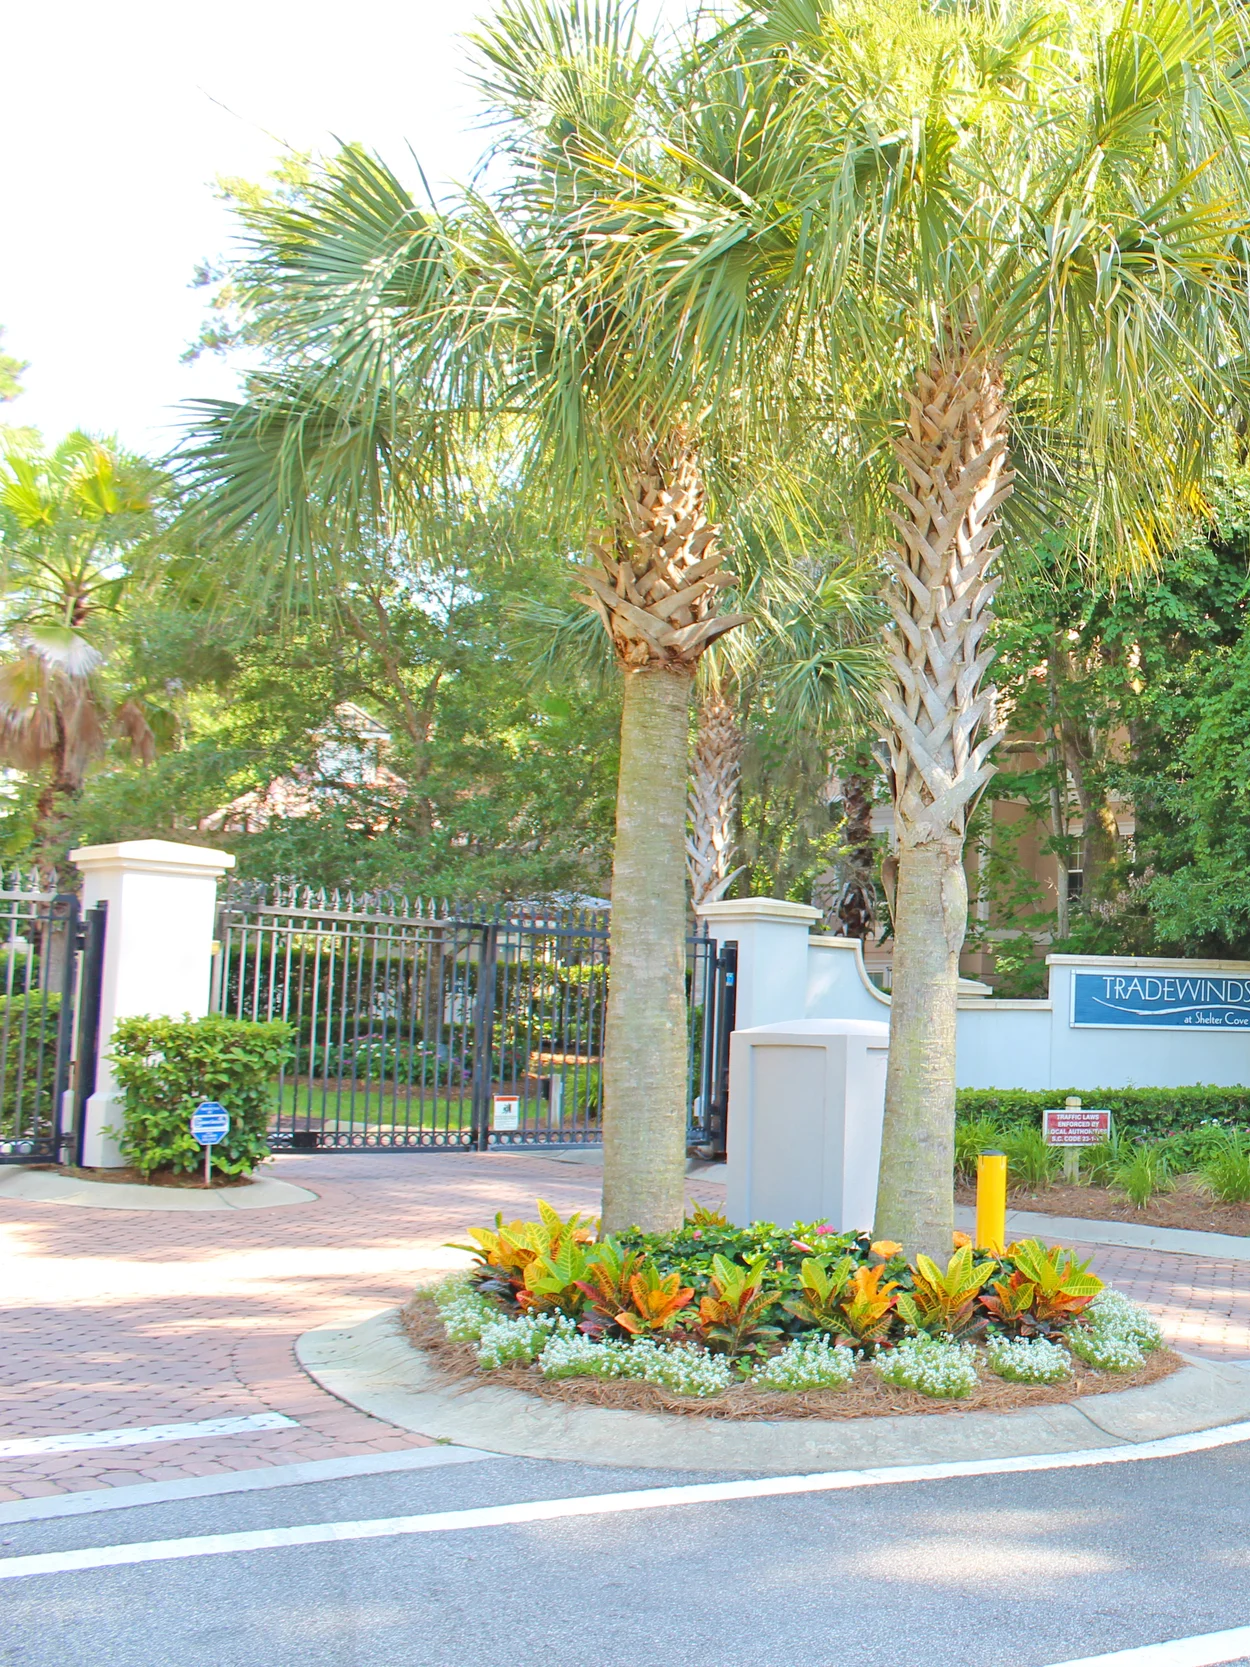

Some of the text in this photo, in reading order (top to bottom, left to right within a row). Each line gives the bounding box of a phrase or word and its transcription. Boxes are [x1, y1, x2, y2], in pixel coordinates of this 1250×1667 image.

[1183, 1011, 1249, 1025] at Shelter Cove
